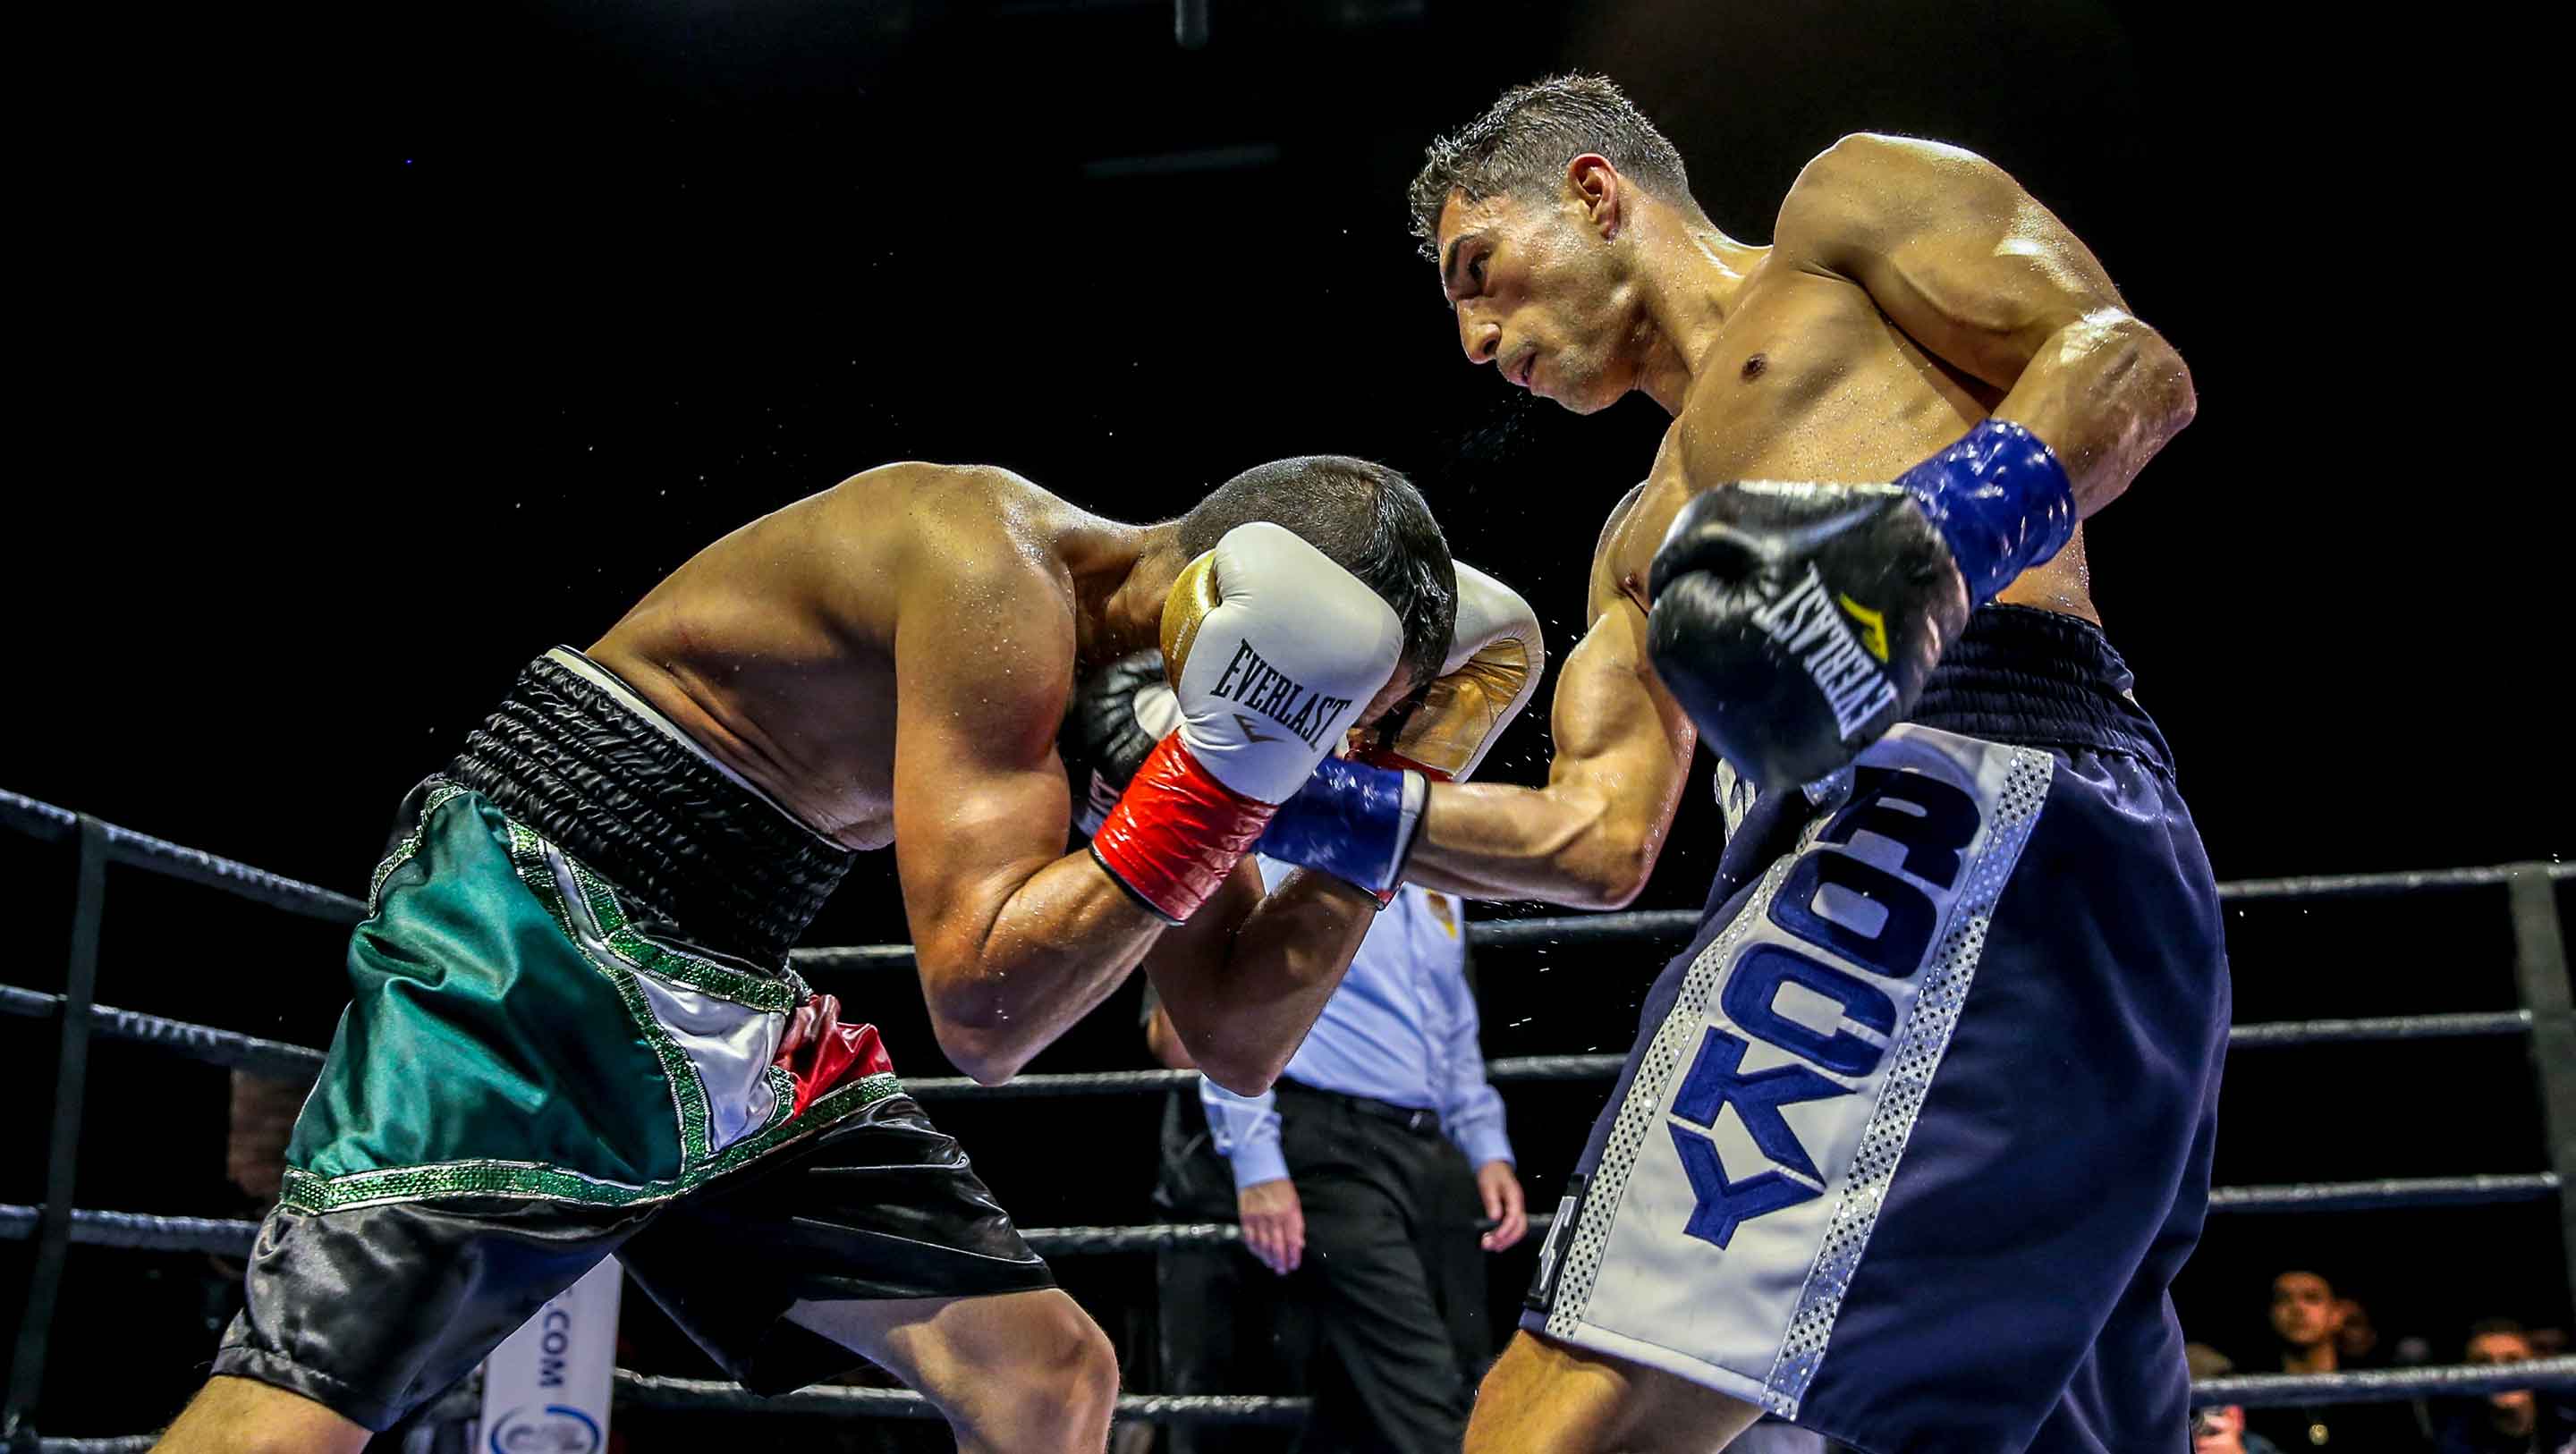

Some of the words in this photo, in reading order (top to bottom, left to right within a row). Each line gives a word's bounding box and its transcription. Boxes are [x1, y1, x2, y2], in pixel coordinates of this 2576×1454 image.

[1210, 638, 1352, 753] EVERLAST
[1751, 559, 1900, 741] EVERLAST
[1667, 765, 1981, 1251] ROCKY
[538, 1289, 573, 1388] .COM
